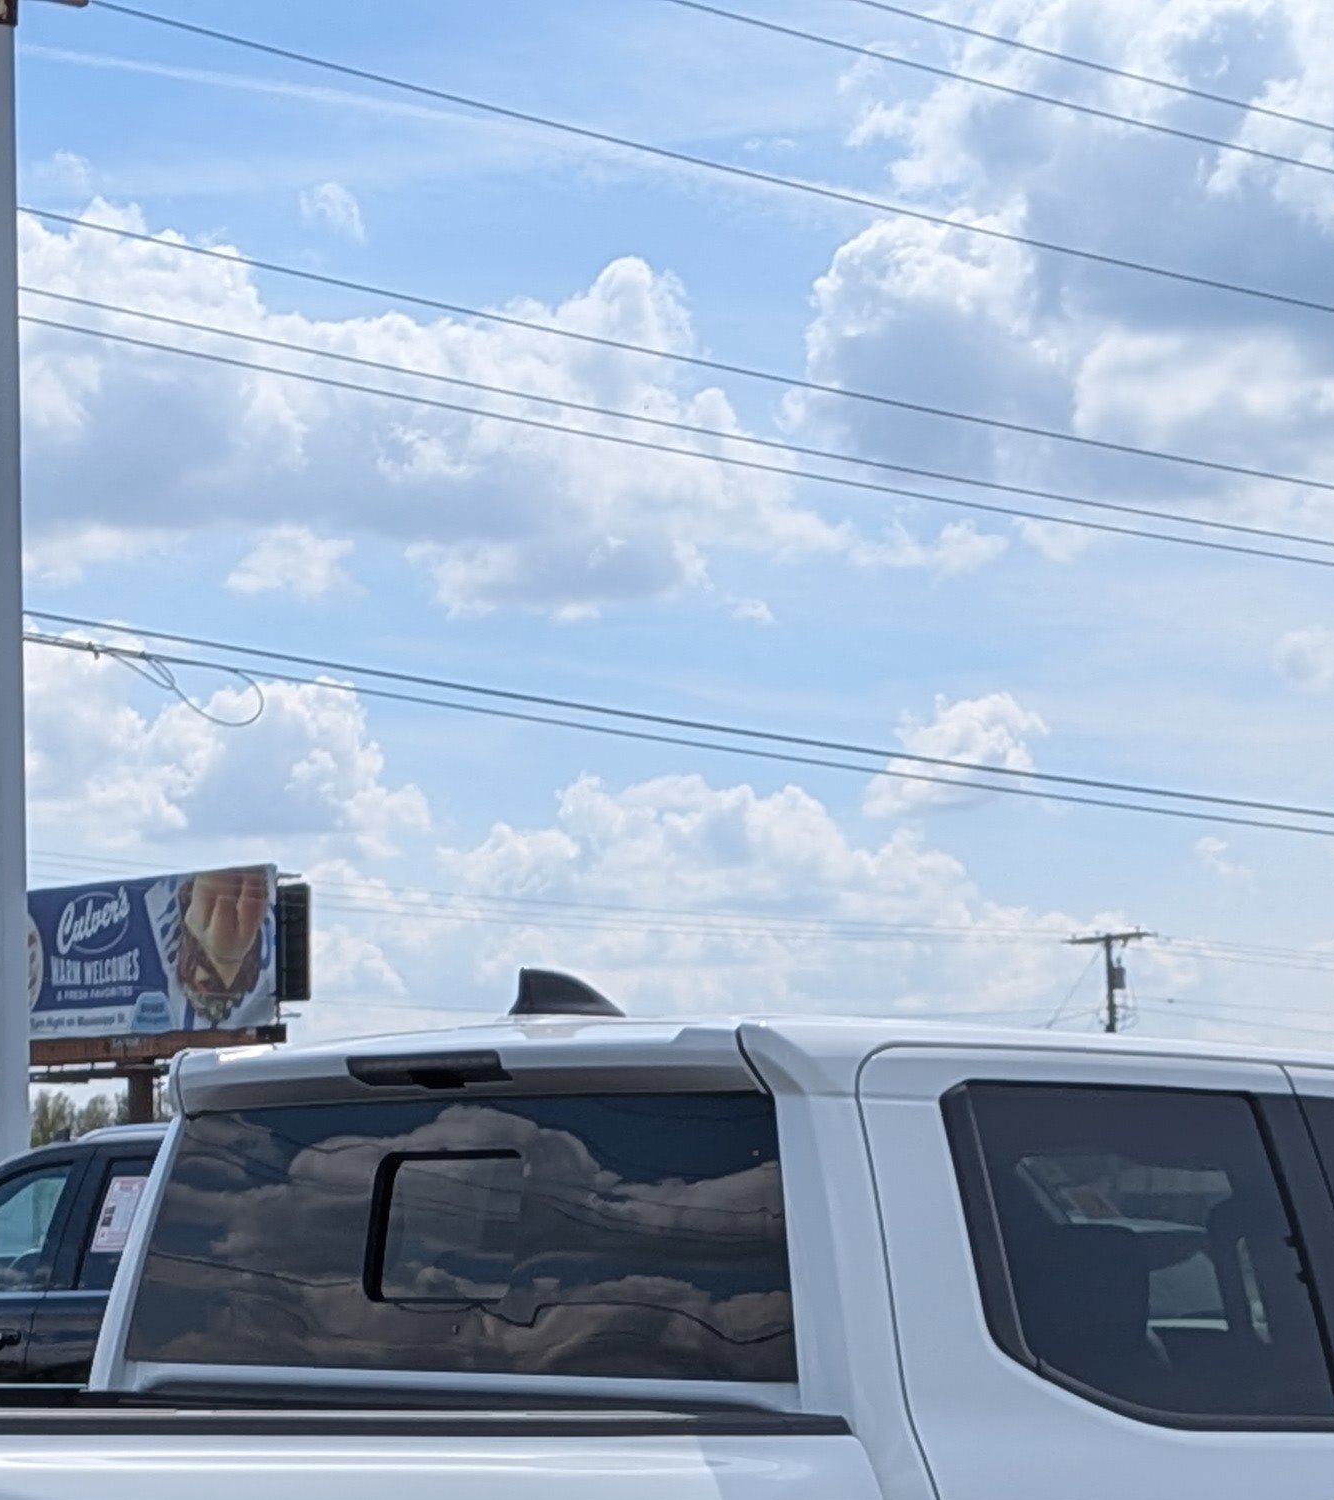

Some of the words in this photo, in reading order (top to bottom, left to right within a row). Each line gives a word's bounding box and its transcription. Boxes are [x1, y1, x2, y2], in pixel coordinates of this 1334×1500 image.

[56, 885, 130, 955] Culver's
[50, 955, 81, 987] WARM
[84, 947, 140, 985] WELCOMES
